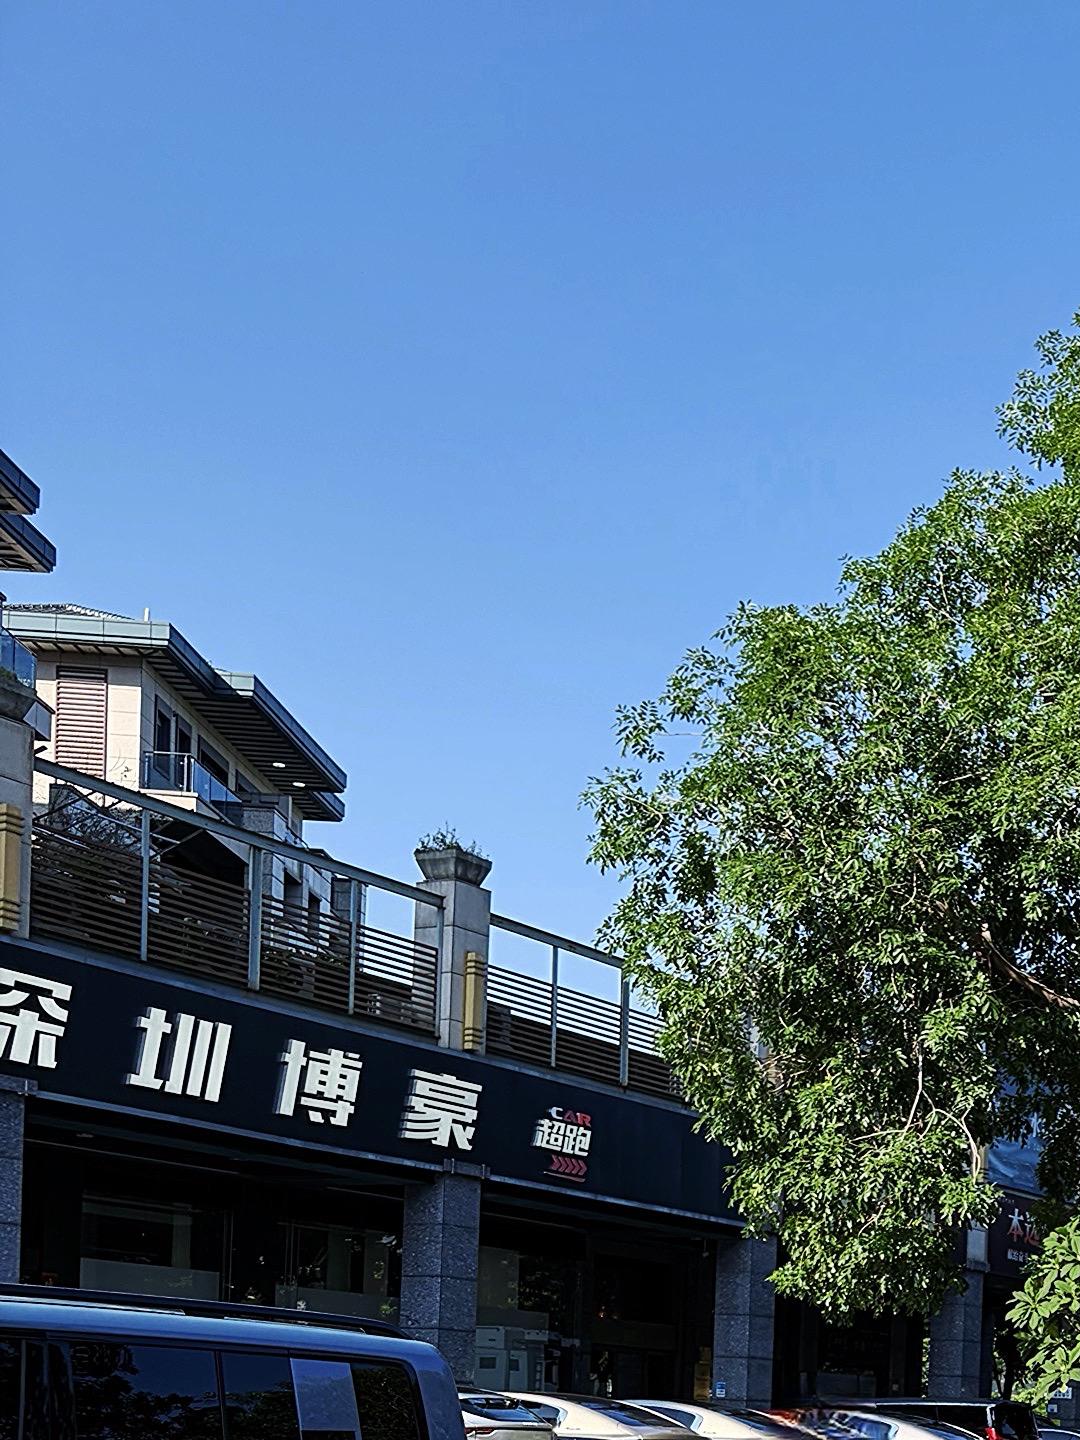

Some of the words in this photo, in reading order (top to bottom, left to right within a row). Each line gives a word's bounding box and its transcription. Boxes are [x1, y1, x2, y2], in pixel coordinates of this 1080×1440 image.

[0, 967, 483, 1151] 深圳博豪
[549, 1106, 592, 1127] CAR
[534, 1118, 592, 1157] 超跑
